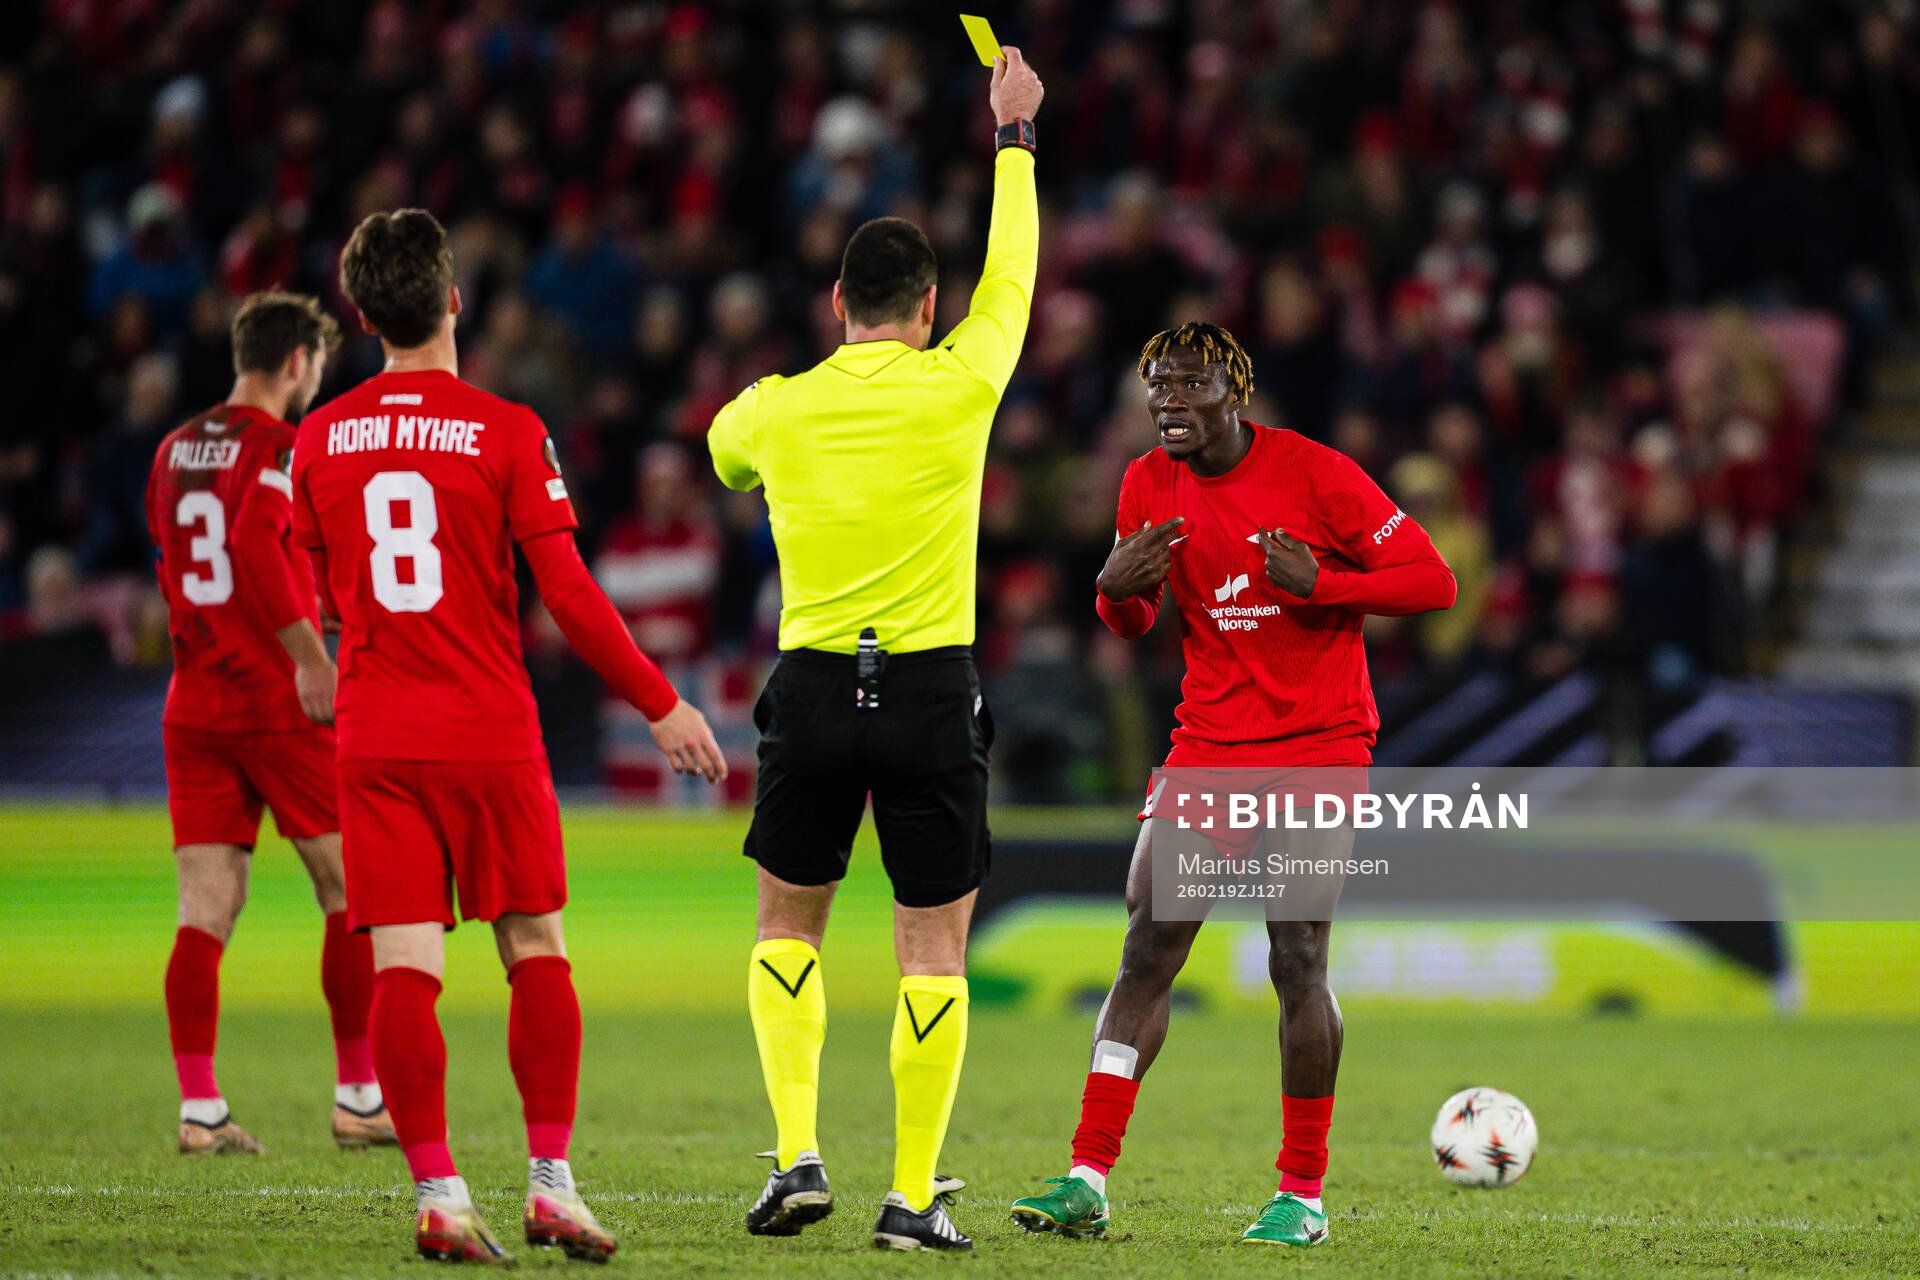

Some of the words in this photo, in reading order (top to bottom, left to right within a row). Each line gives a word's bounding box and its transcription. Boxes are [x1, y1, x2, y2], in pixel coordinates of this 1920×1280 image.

[327, 415, 391, 456] HORN
[395, 414, 486, 457] MYHRE
[177, 491, 234, 606] 3
[363, 471, 444, 613] 8
[1205, 604, 1280, 619] arebanken
[1218, 617, 1258, 632] Norge
